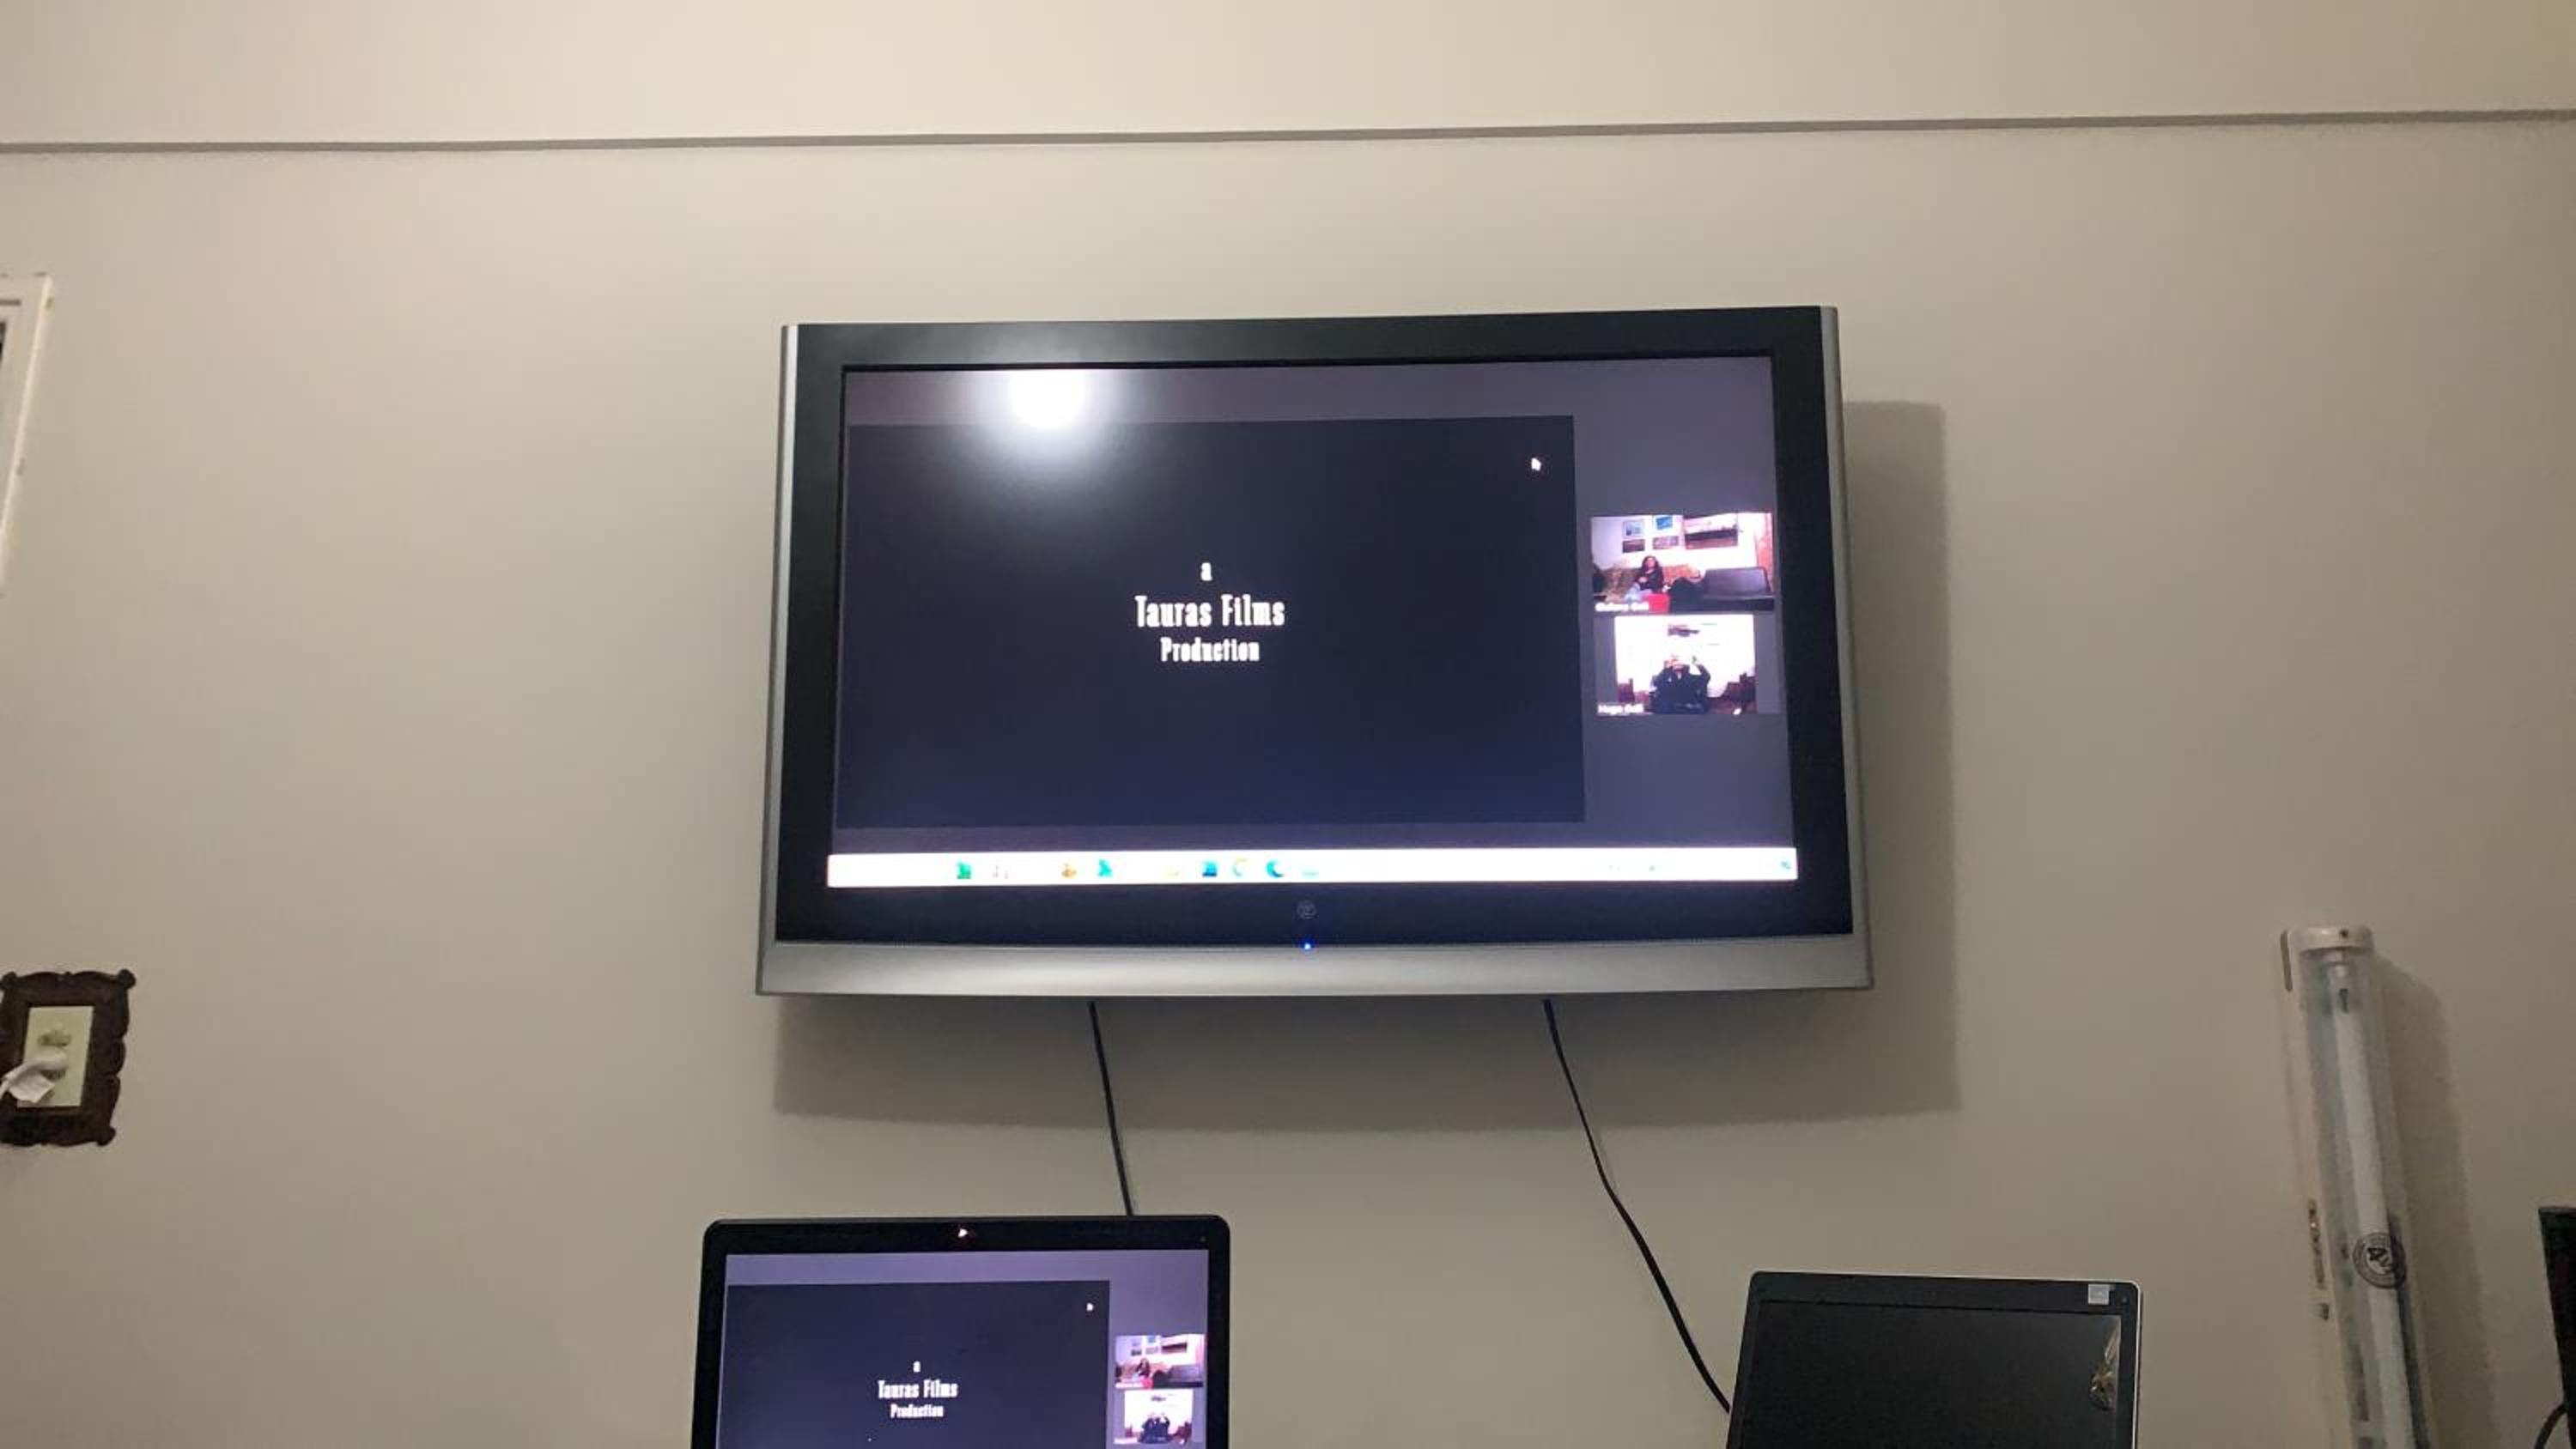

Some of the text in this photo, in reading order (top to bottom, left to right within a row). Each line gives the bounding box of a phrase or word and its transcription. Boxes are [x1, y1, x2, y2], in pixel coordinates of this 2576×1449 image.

[1200, 562, 1212, 582] a
[1134, 593, 1285, 627] Tauras Films
[1160, 636, 1260, 662] Production
[913, 1361, 921, 1373] a
[923, 1378, 959, 1399] Films
[890, 1403, 945, 1419] Production
